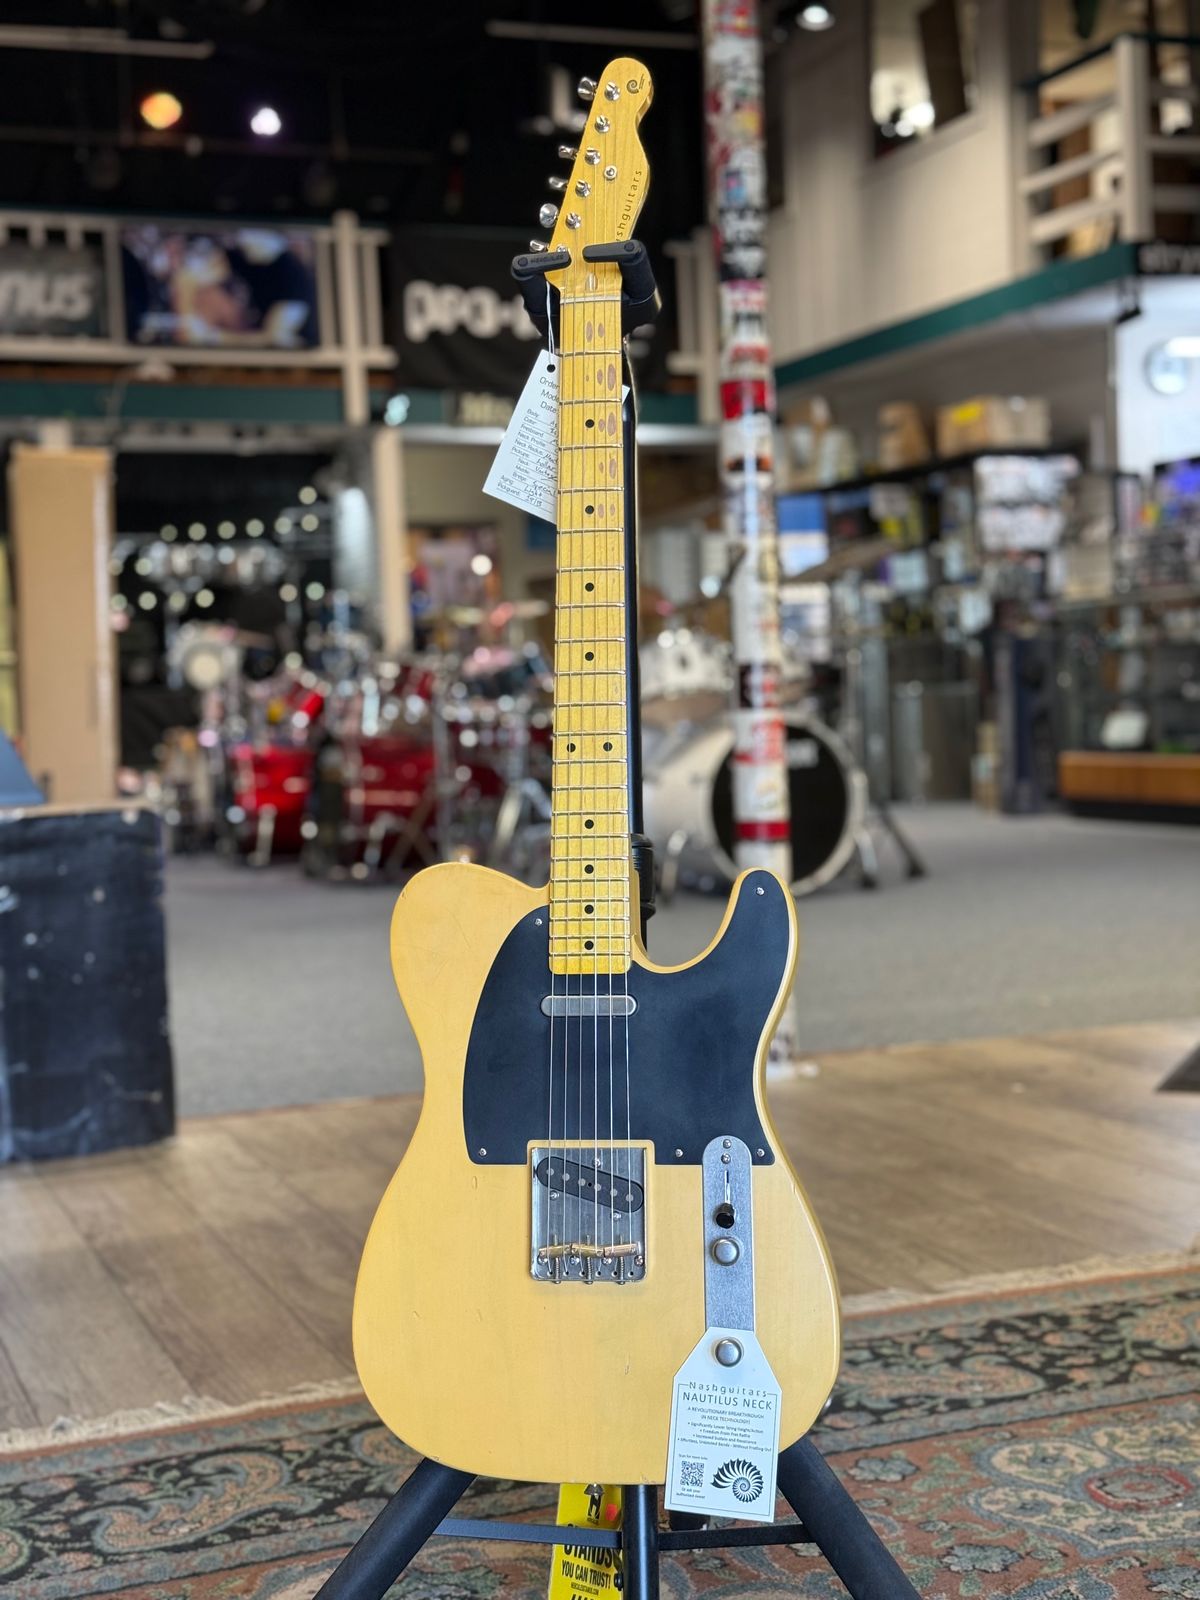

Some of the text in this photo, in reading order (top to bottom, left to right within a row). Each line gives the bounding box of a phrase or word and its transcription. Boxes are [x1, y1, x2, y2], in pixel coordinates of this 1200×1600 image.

[615, 169, 643, 242] shguitars
[689, 1381, 767, 1397] Nashguitars
[682, 1392, 772, 1410] NAUTILUS NECK
[728, 1411, 764, 1419] BREAKTHROUGH
[561, 1560, 612, 1589] YOU CAN TRUST!
